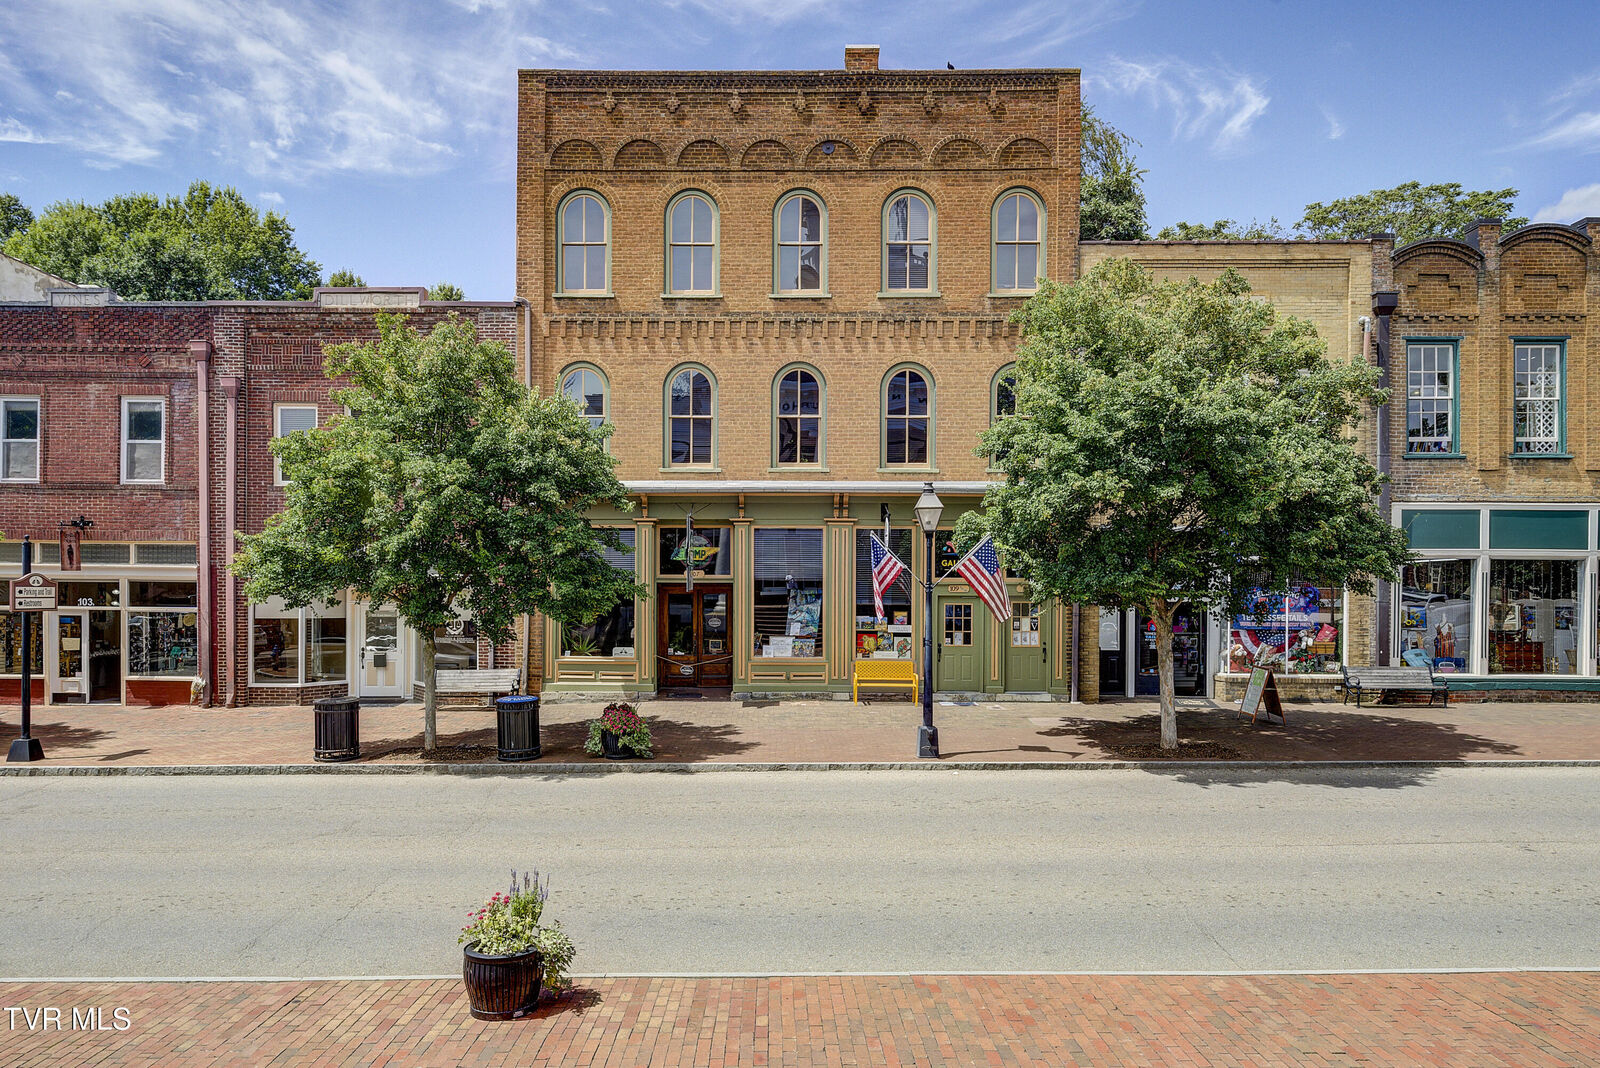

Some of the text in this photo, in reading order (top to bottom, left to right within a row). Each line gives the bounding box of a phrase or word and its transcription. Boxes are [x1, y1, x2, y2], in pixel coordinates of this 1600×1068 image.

[23, 588, 37, 597] Parking
[77, 597, 93, 606] 103
[1289, 614, 1308, 622] TAILS
